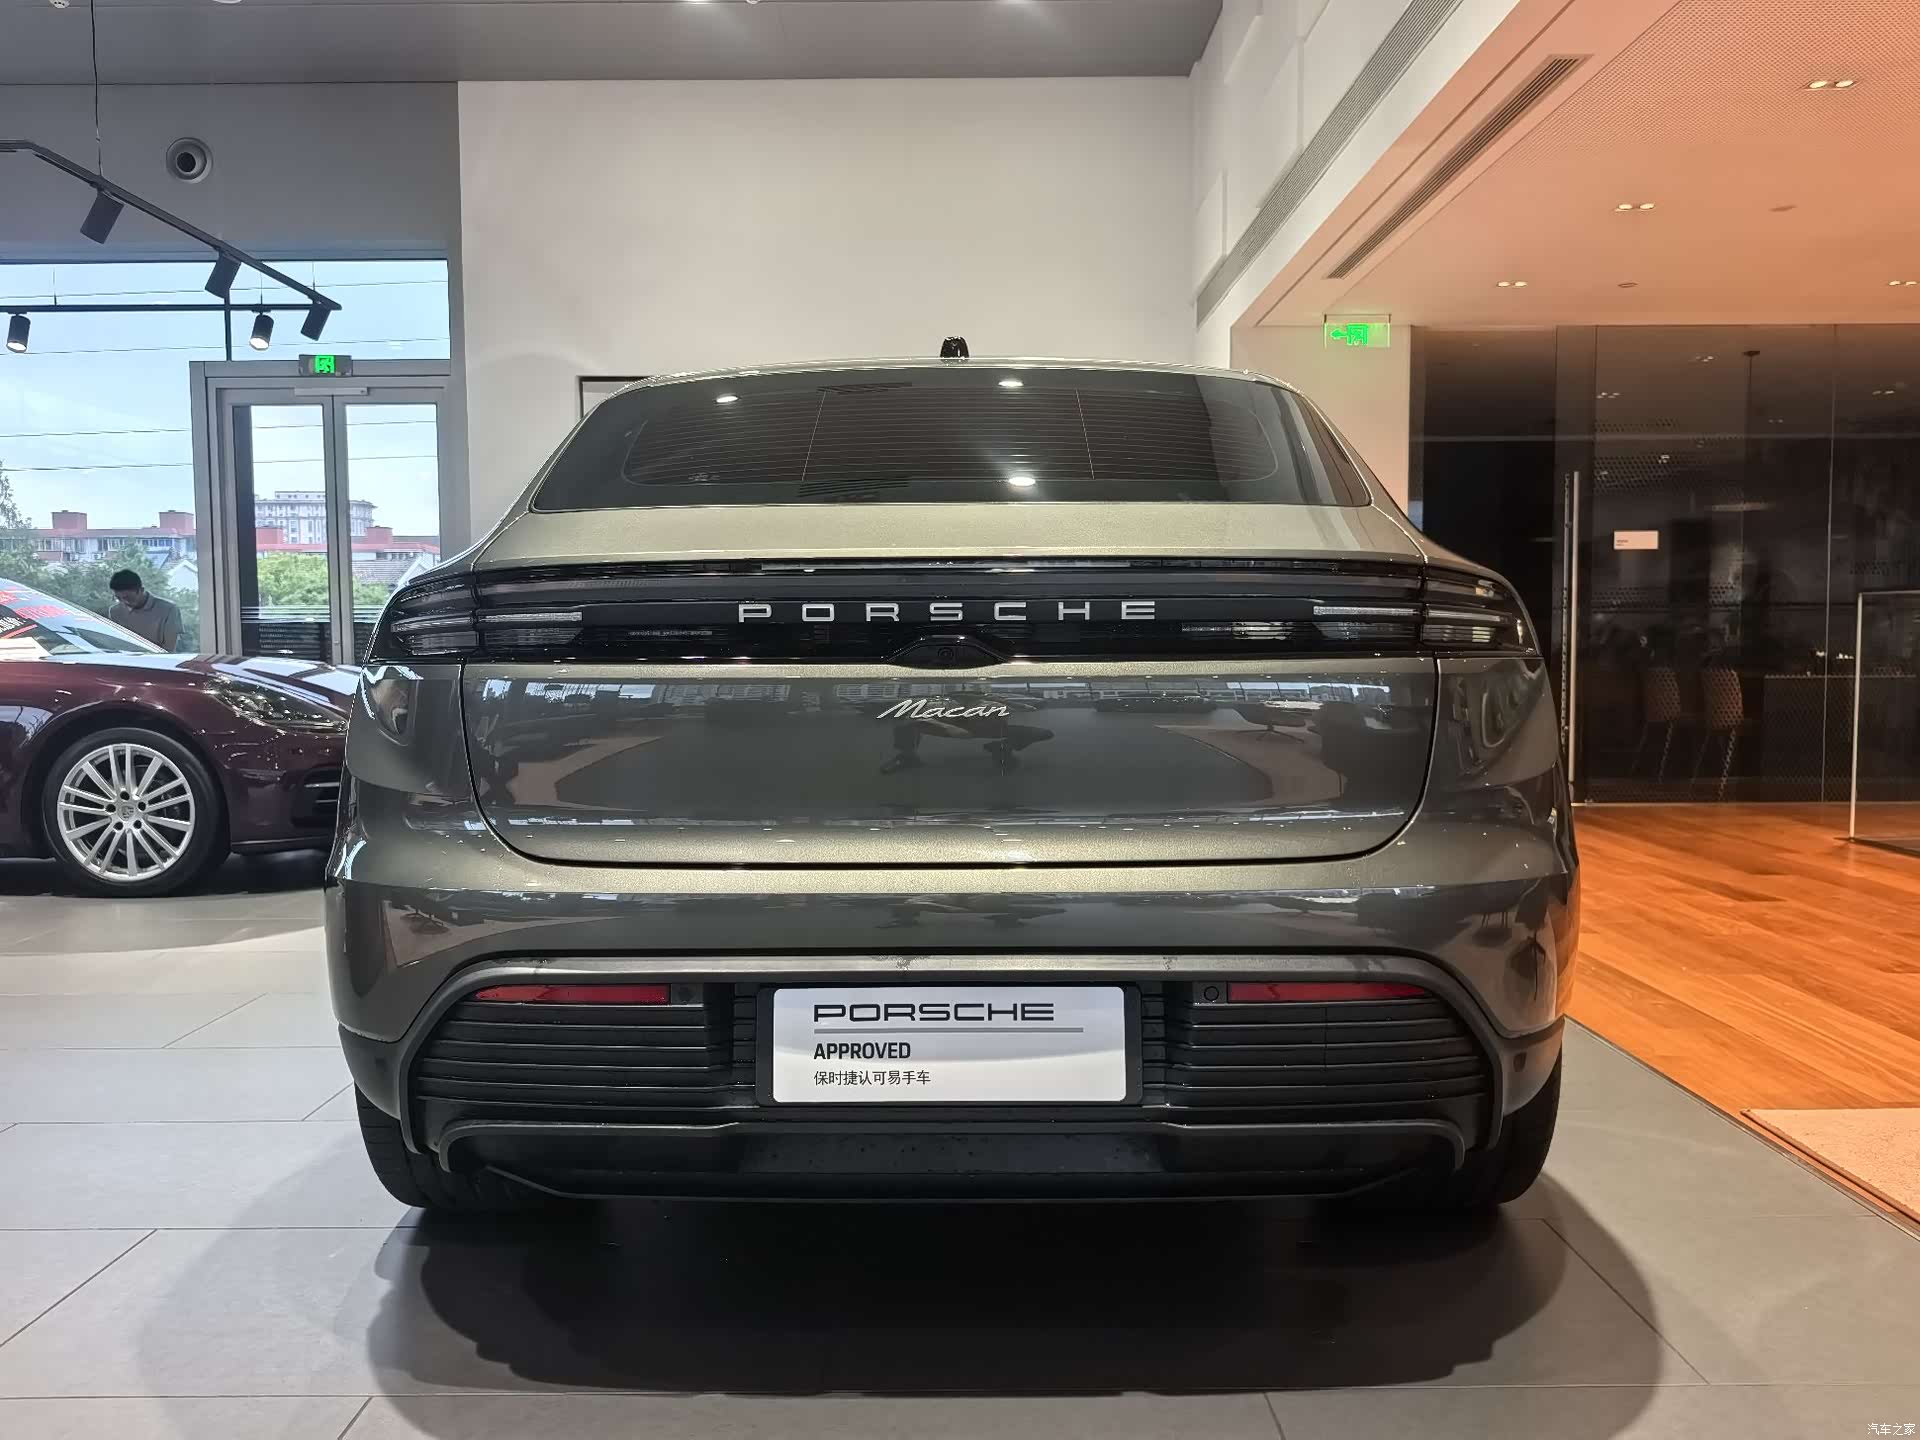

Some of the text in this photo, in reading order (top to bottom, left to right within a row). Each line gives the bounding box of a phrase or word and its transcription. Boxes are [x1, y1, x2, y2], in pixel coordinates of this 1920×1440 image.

[738, 600, 1156, 623] PORSCHE
[876, 699, 1010, 719] Macan
[813, 1003, 1055, 1022] PORSCHE
[813, 1042, 912, 1060] APPROVED
[813, 1070, 932, 1086] 保时捷认可易手车
